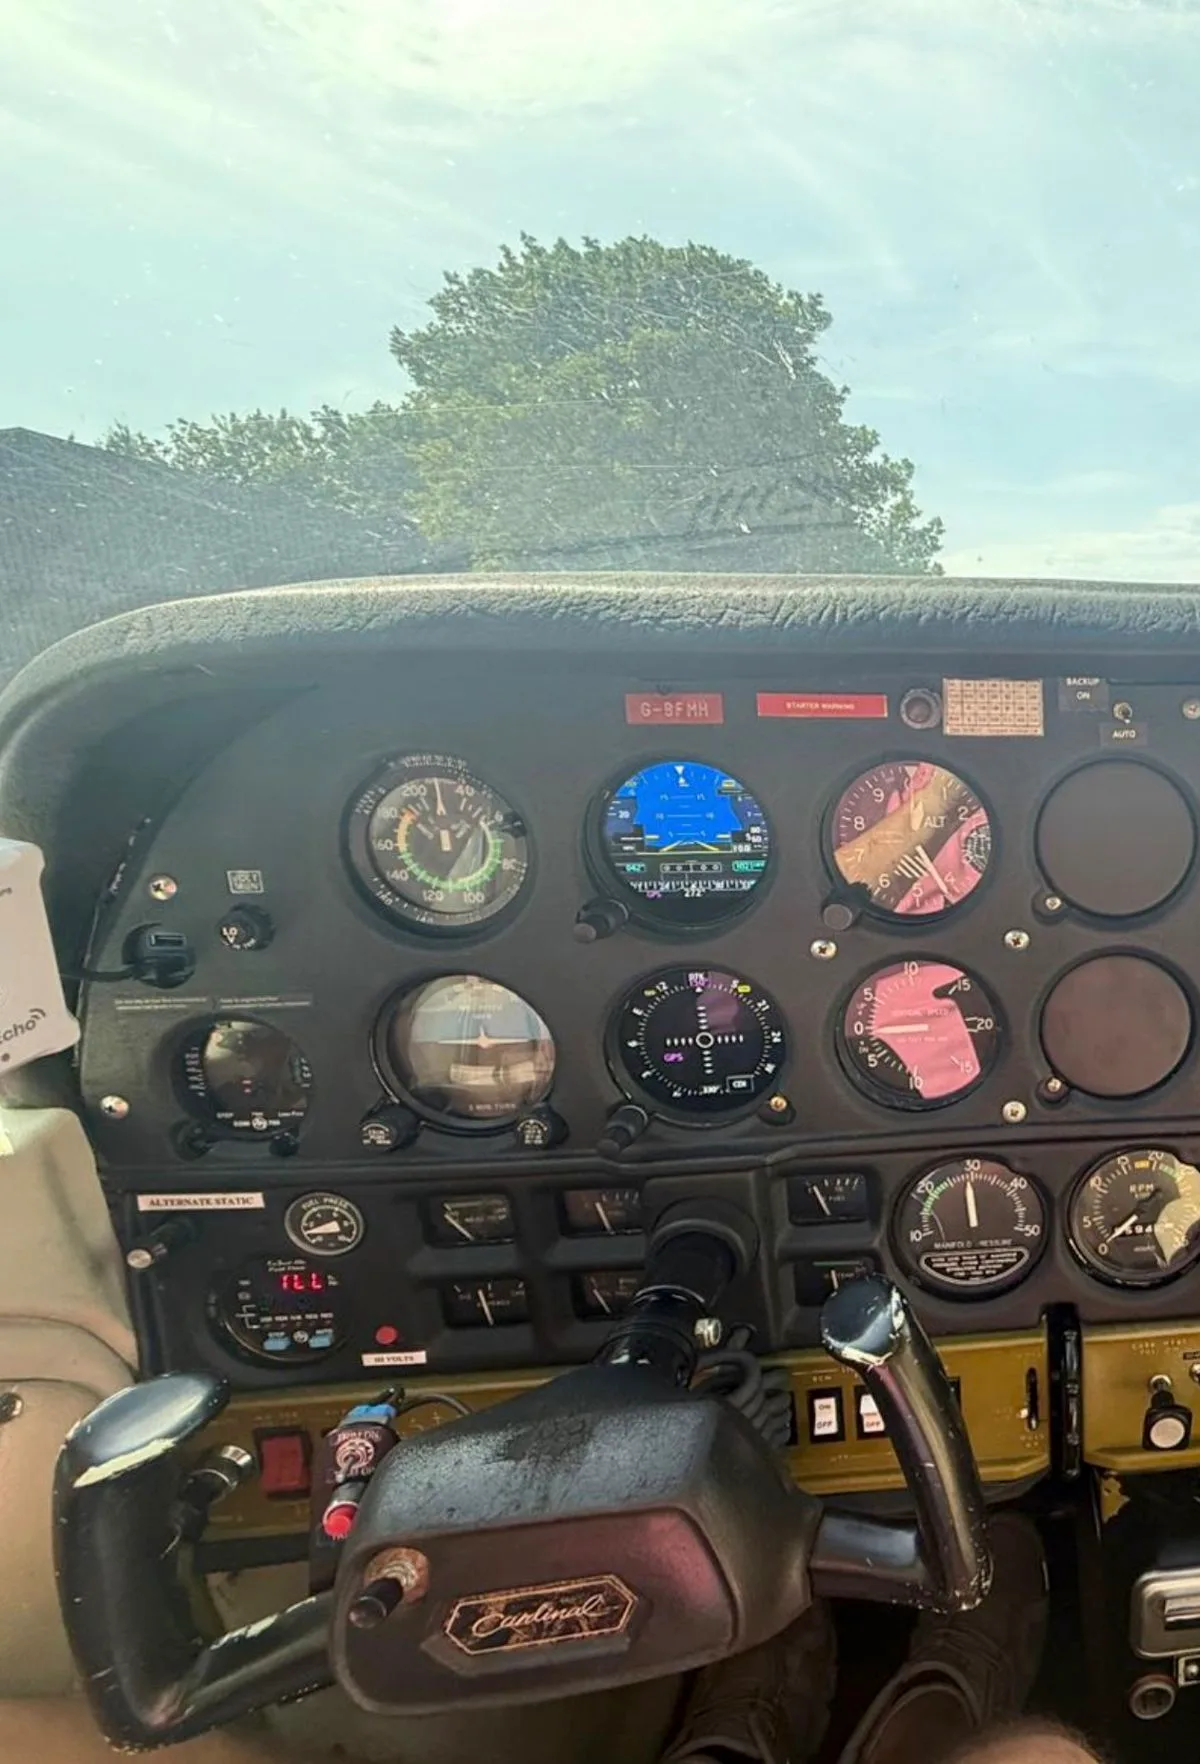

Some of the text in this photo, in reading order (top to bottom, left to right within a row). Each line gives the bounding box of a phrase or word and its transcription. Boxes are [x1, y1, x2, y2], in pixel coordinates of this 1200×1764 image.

[1077, 692, 1090, 700] ON
[1111, 730, 1135, 740] AUTO
[873, 787, 885, 803] 9
[957, 805, 969, 822] 2
[853, 815, 865, 832] 8
[922, 815, 947, 829] ALT
[878, 872, 891, 889] 6
[422, 890, 445, 902] 120
[912, 882, 923, 898] 5
[463, 891, 486, 904] 100
[904, 961, 919, 976] 10
[956, 979, 971, 992] 15
[863, 988, 874, 1002] 5
[0, 1016, 36, 1046] cho
[854, 1022, 864, 1036] 0
[976, 1017, 994, 1031] 20
[867, 1054, 879, 1068] 5
[959, 1060, 974, 1074] 15
[909, 1074, 924, 1090] 10
[963, 1159, 982, 1173] 30
[916, 1180, 935, 1194] 20
[1009, 1176, 1028, 1190] 40
[1129, 1183, 1154, 1193] RPM
[1082, 1215, 1093, 1229] 5
[909, 1229, 923, 1242] 10
[1023, 1224, 1041, 1237] 50
[1098, 1243, 1108, 1255] 0
[816, 1421, 833, 1429] OFF
[472, 1594, 612, 1639] Cardinal
